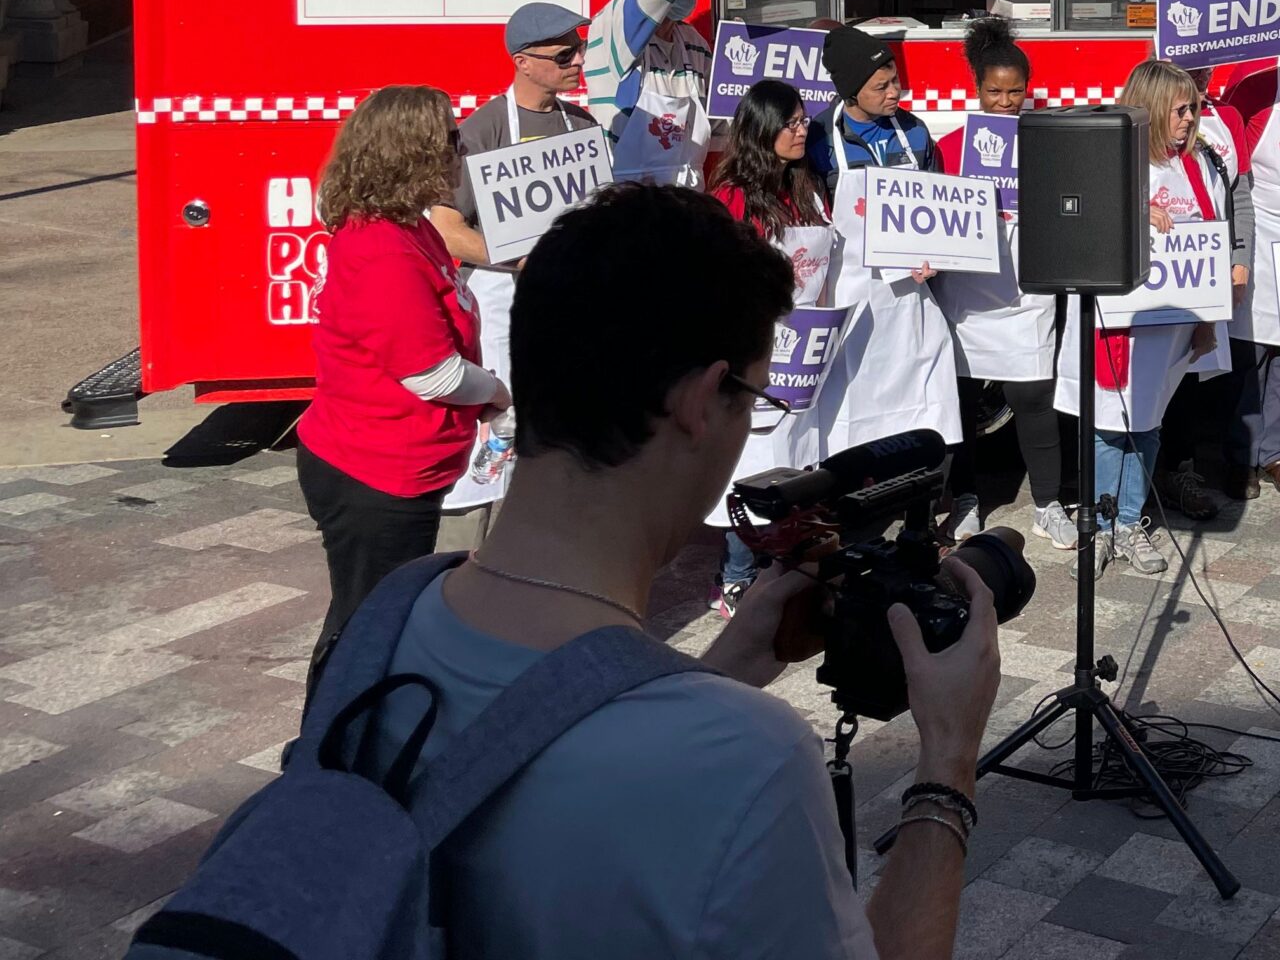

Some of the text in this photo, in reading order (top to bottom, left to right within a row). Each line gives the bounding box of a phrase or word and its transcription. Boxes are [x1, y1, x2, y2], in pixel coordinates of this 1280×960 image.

[480, 139, 599, 185] FAIR MAPS
[876, 178, 988, 207] FAIR MAPS
[1158, 191, 1196, 210] Gerry'
[881, 203, 984, 240] NOW!
[1164, 233, 1222, 253] MAPS
[1143, 256, 1217, 291] OW!
